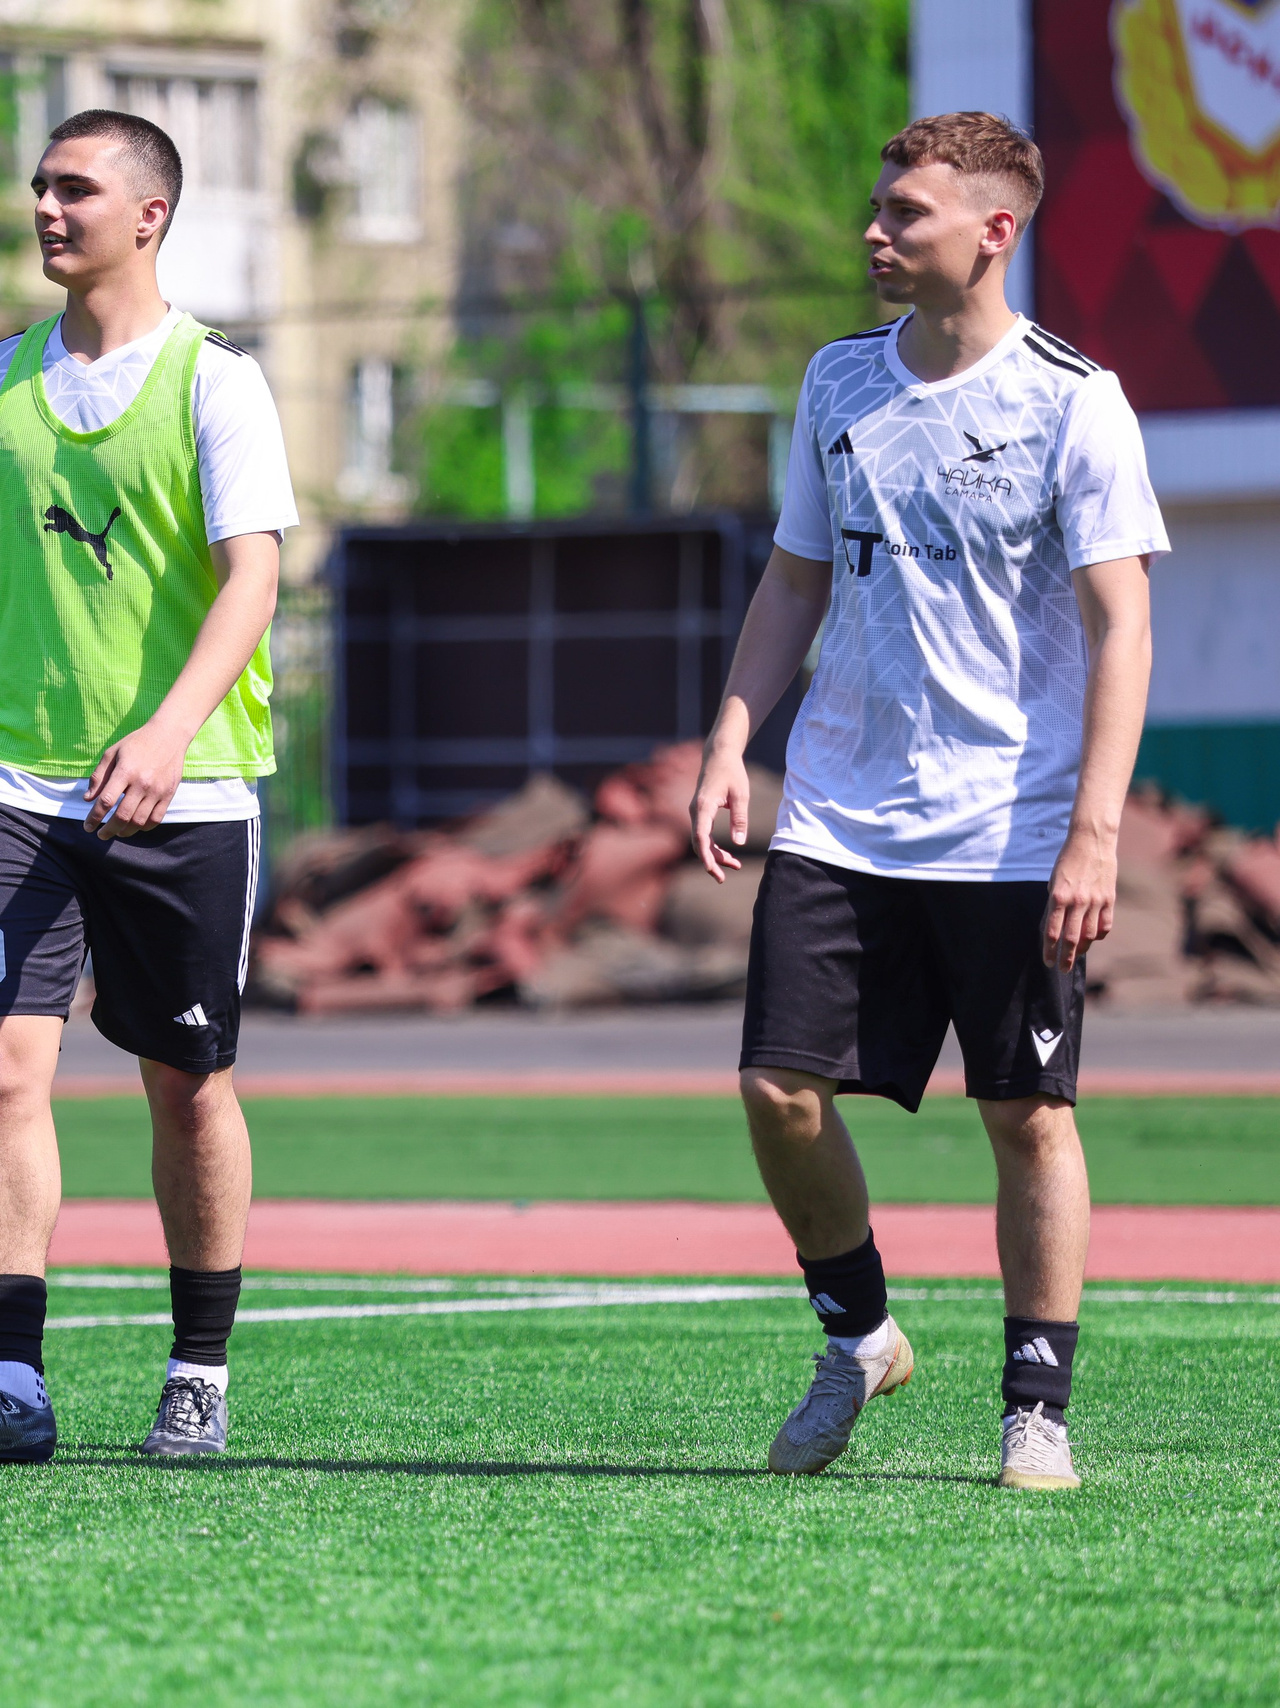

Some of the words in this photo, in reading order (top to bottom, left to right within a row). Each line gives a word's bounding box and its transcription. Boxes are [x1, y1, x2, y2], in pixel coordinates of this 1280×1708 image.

[937, 466, 1012, 496] ЧАЙКА
[944, 486, 993, 504] САМАРА
[924, 544, 957, 560] Tab
